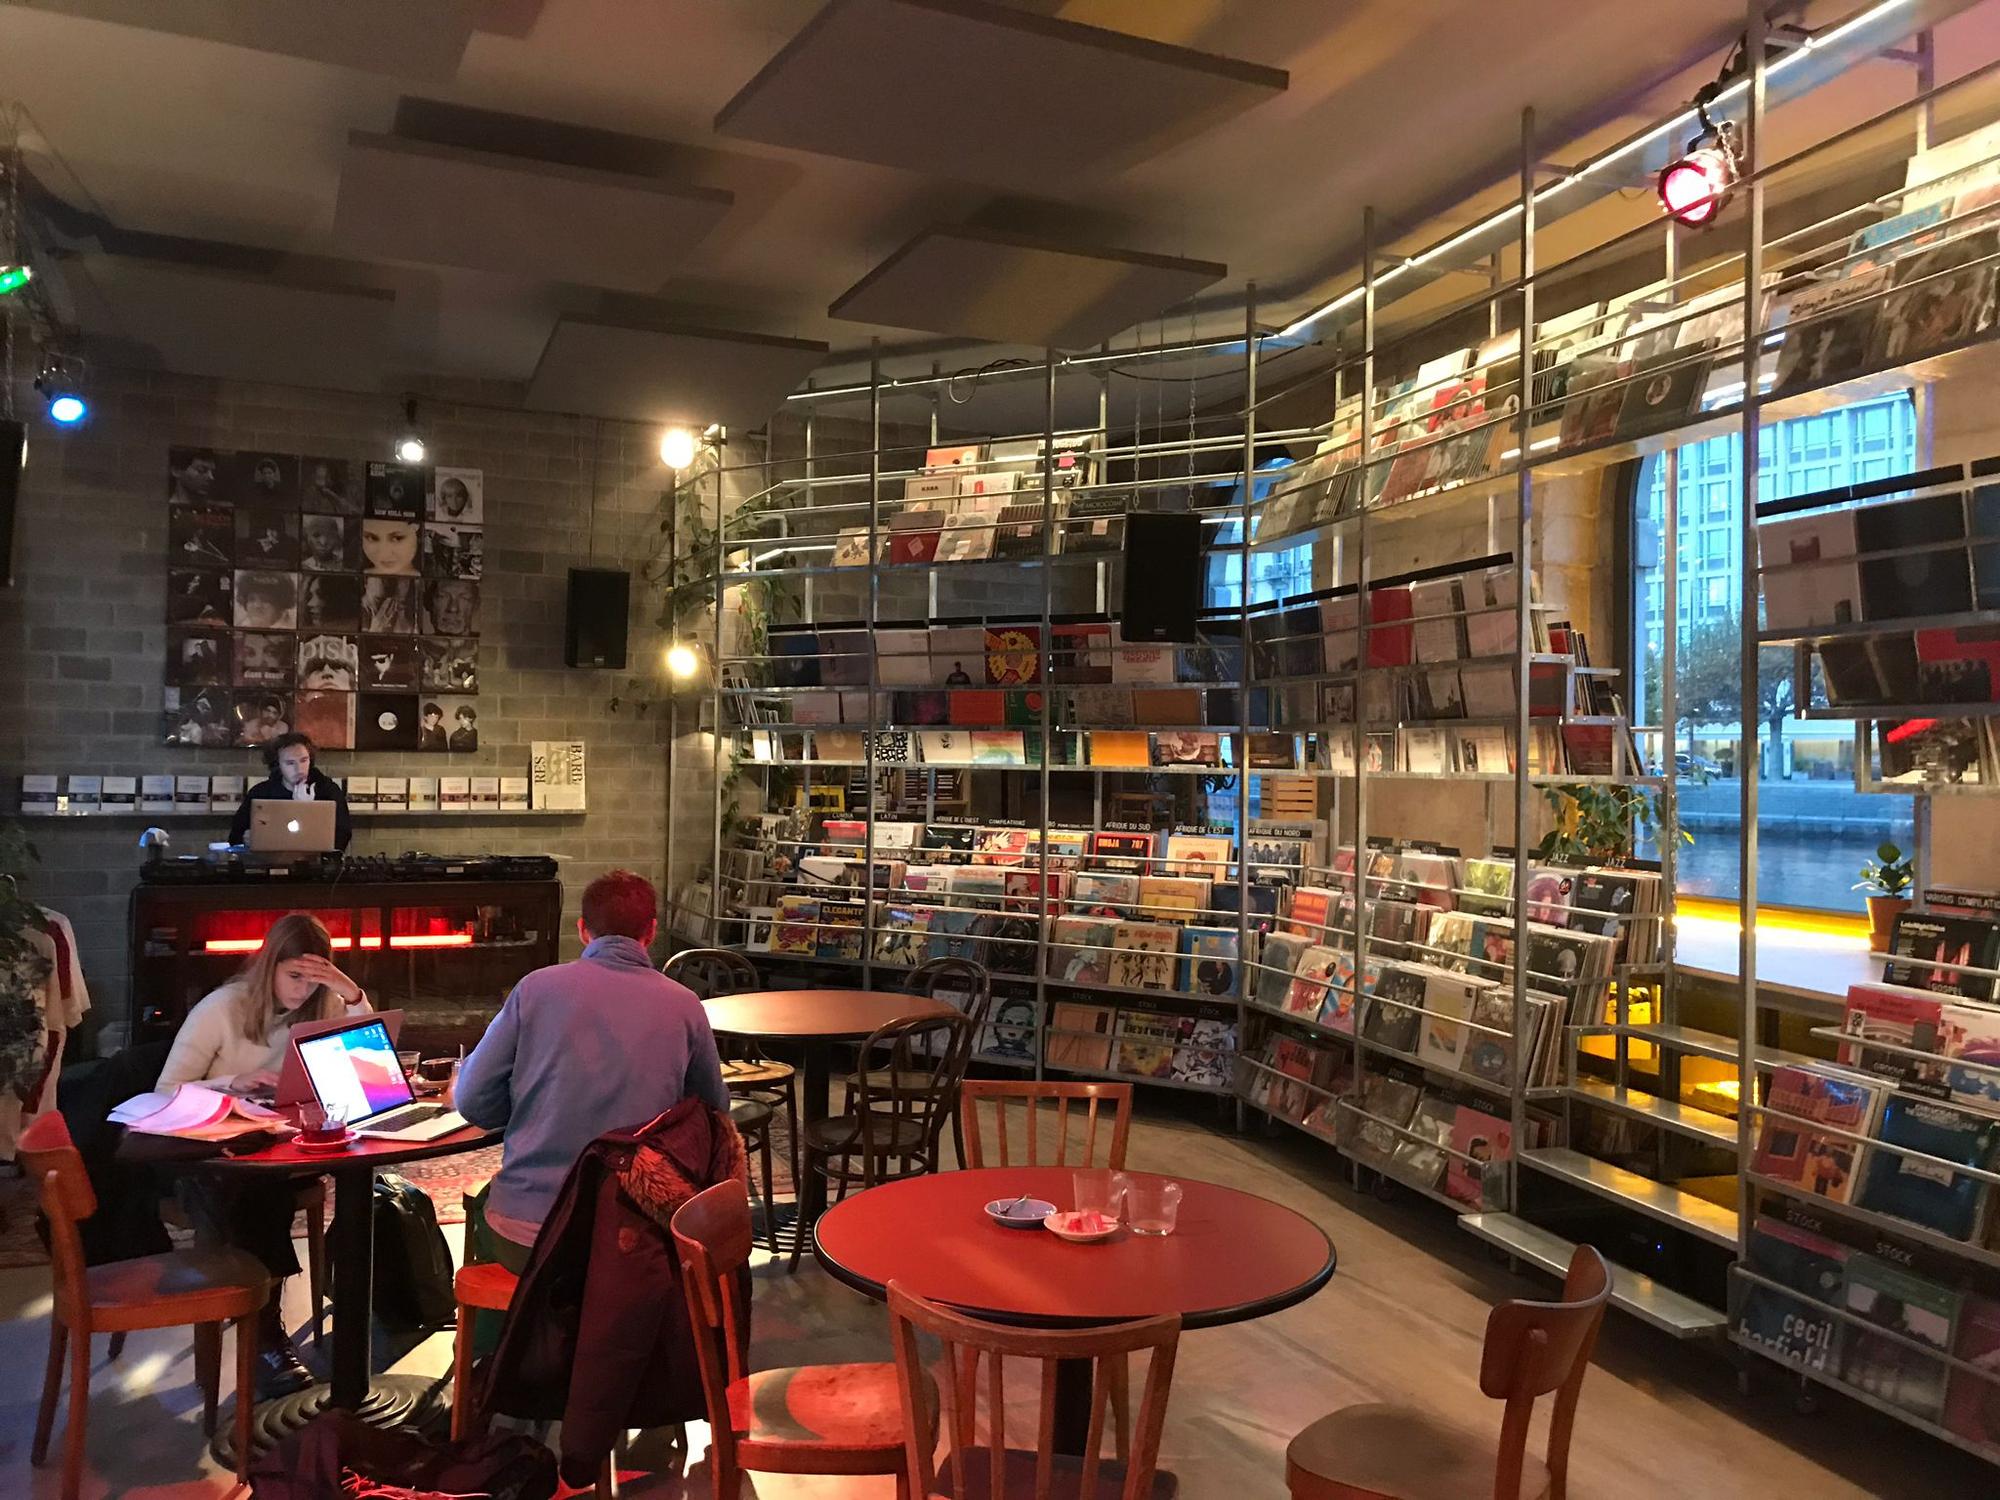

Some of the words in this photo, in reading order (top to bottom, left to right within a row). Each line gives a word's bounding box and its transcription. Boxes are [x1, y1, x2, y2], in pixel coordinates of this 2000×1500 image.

[534, 756, 546, 783] RES
[1105, 821, 1128, 829] AFRIQUE
[1129, 822, 1137, 830] DU
[1138, 823, 1151, 831] SUD
[1175, 825, 1198, 833] AFRIQUE
[1199, 826, 1206, 834] DE
[1207, 826, 1226, 834] L'EST
[1249, 828, 1272, 836] AFRIQUE
[1284, 829, 1301, 837] NORD
[1550, 853, 1569, 863] JAZZ
[1605, 858, 1626, 868] JAZZ
[1931, 983, 1963, 996] GOSPEL
[1786, 1209, 1823, 1233] STOCK
[1876, 1241, 1913, 1266] STOCK
[1783, 1314, 1833, 1350] cecil
